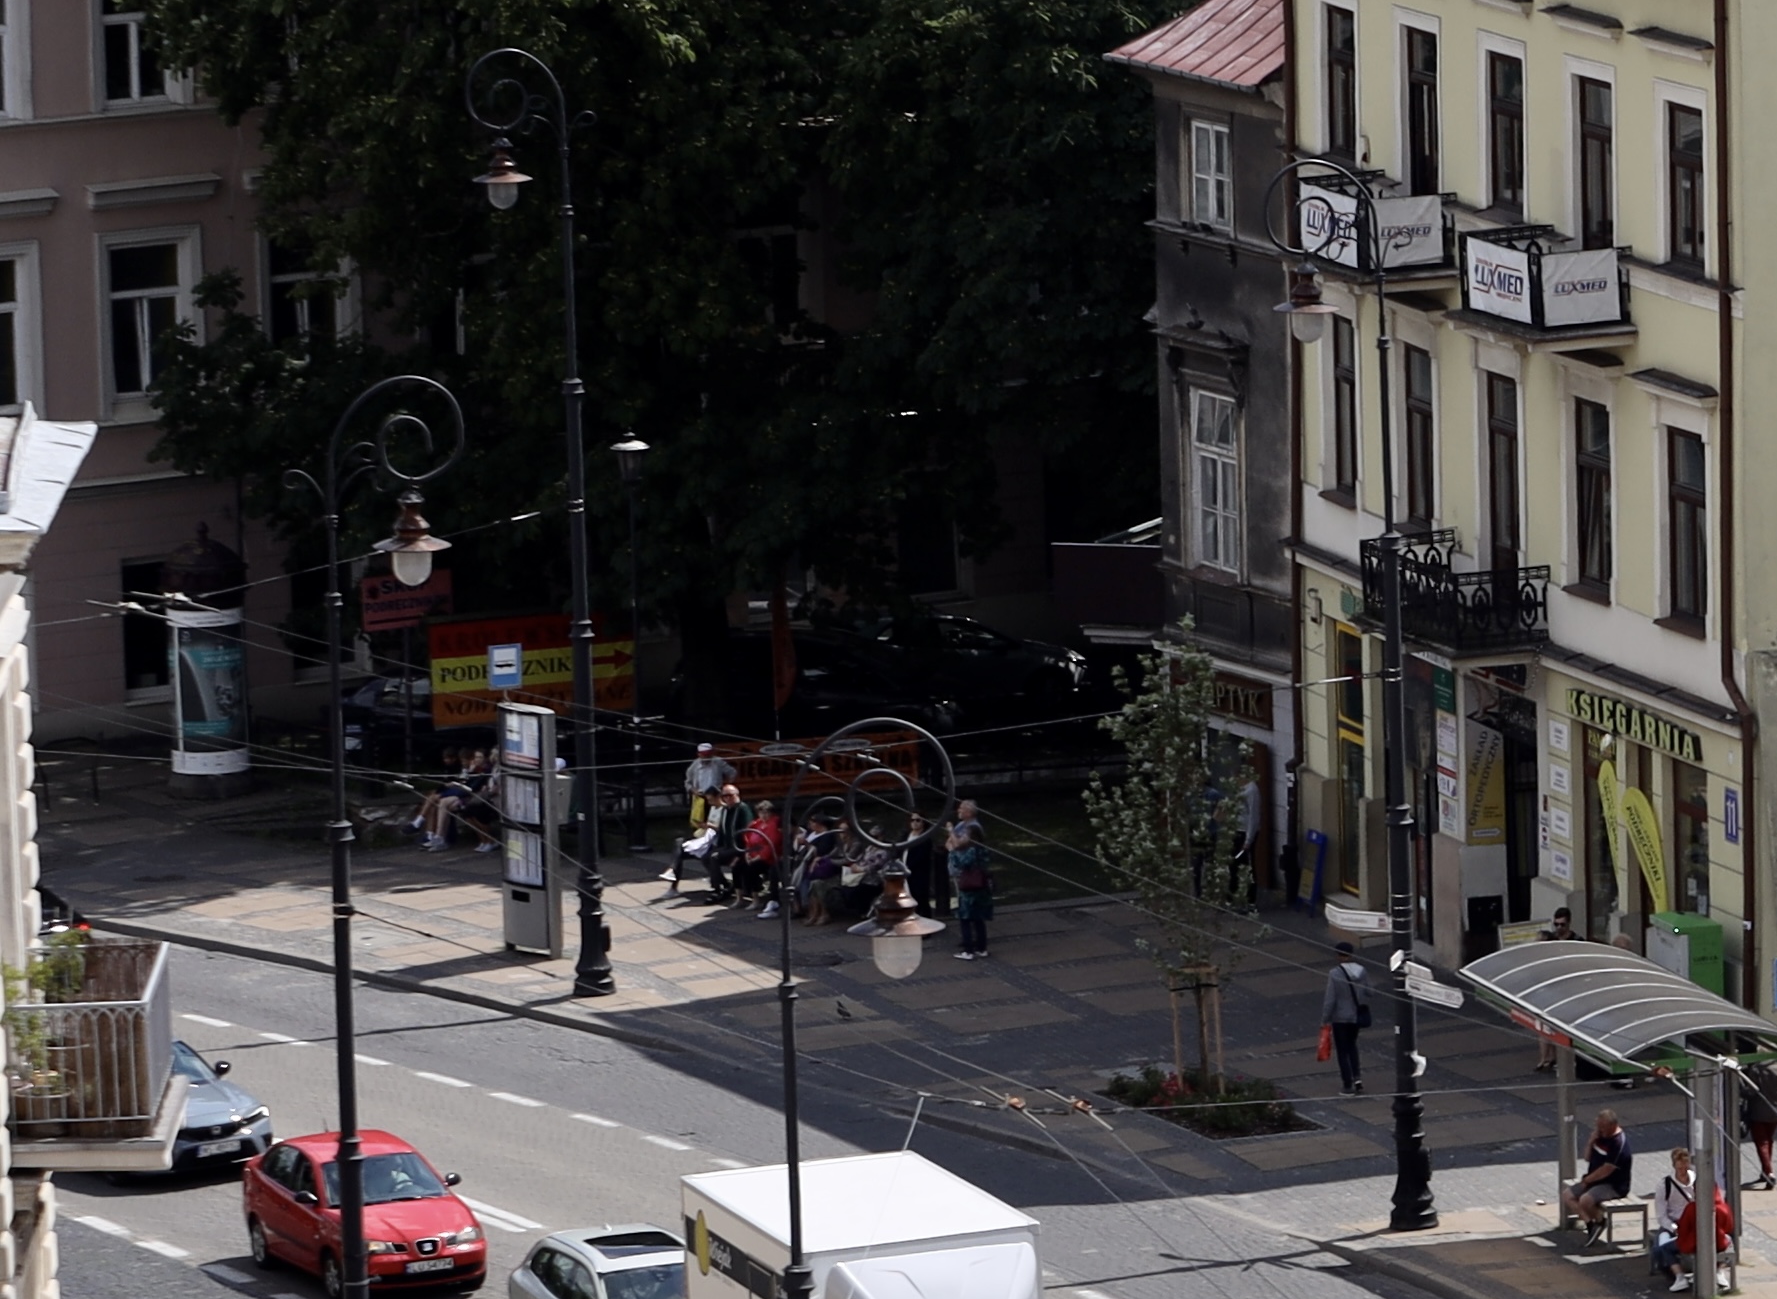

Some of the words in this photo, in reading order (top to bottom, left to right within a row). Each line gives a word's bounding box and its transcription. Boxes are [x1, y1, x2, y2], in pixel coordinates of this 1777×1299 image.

[1473, 264, 1525, 296] LUXMED
[1554, 279, 1609, 296] LUXMED
[1565, 688, 1704, 763] KSIĘGARNIA
[1469, 730, 1489, 777] ZAKŁAD
[1468, 733, 1502, 827] ORTOPEDYCZNY
[1725, 796, 1738, 830] 11
